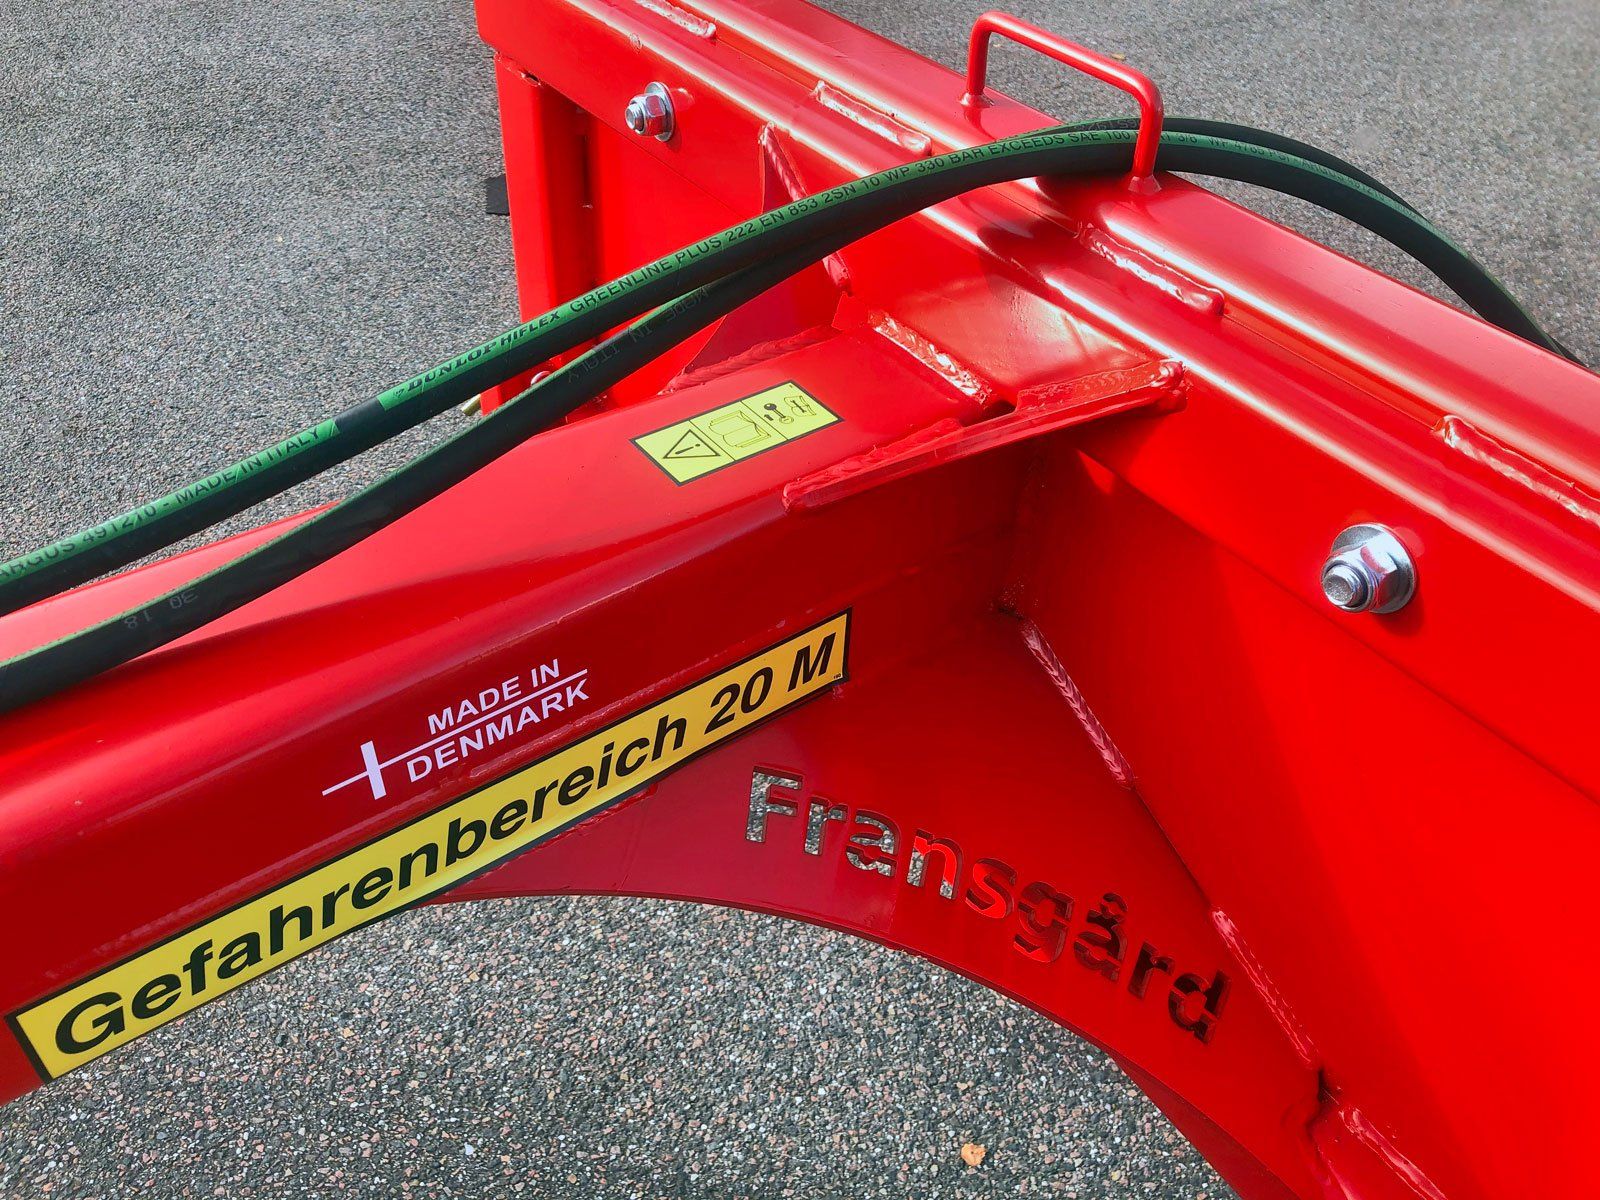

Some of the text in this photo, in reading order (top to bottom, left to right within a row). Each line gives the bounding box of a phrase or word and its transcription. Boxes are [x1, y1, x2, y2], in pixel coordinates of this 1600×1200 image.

[407, 341, 497, 391] DUNLOP
[499, 312, 560, 346] HIFLEX
[569, 259, 672, 313] GREENLINE
[676, 236, 721, 265] PLUS
[726, 222, 757, 243] 222
[759, 211, 785, 228] EN
[788, 198, 819, 217] 853
[822, 183, 857, 204] 2SN
[861, 176, 880, 190] 10
[885, 166, 911, 183] WP
[917, 156, 945, 173] 330
[949, 148, 985, 165] BAR
[989, 133, 1066, 155] EXCEEDS
[1068, 130, 1101, 143] SAE
[1106, 130, 1130, 141] 100
[0, 541, 75, 579] ARGUS
[175, 469, 237, 505] MADE
[240, 455, 263, 475] IN
[266, 426, 320, 461] ITALY
[406, 678, 590, 783] DENMARK
[427, 658, 560, 735] MADE IN
[55, 631, 837, 1055] Gefahrenbereich 20 M
[744, 763, 1234, 1046] Fransgård
